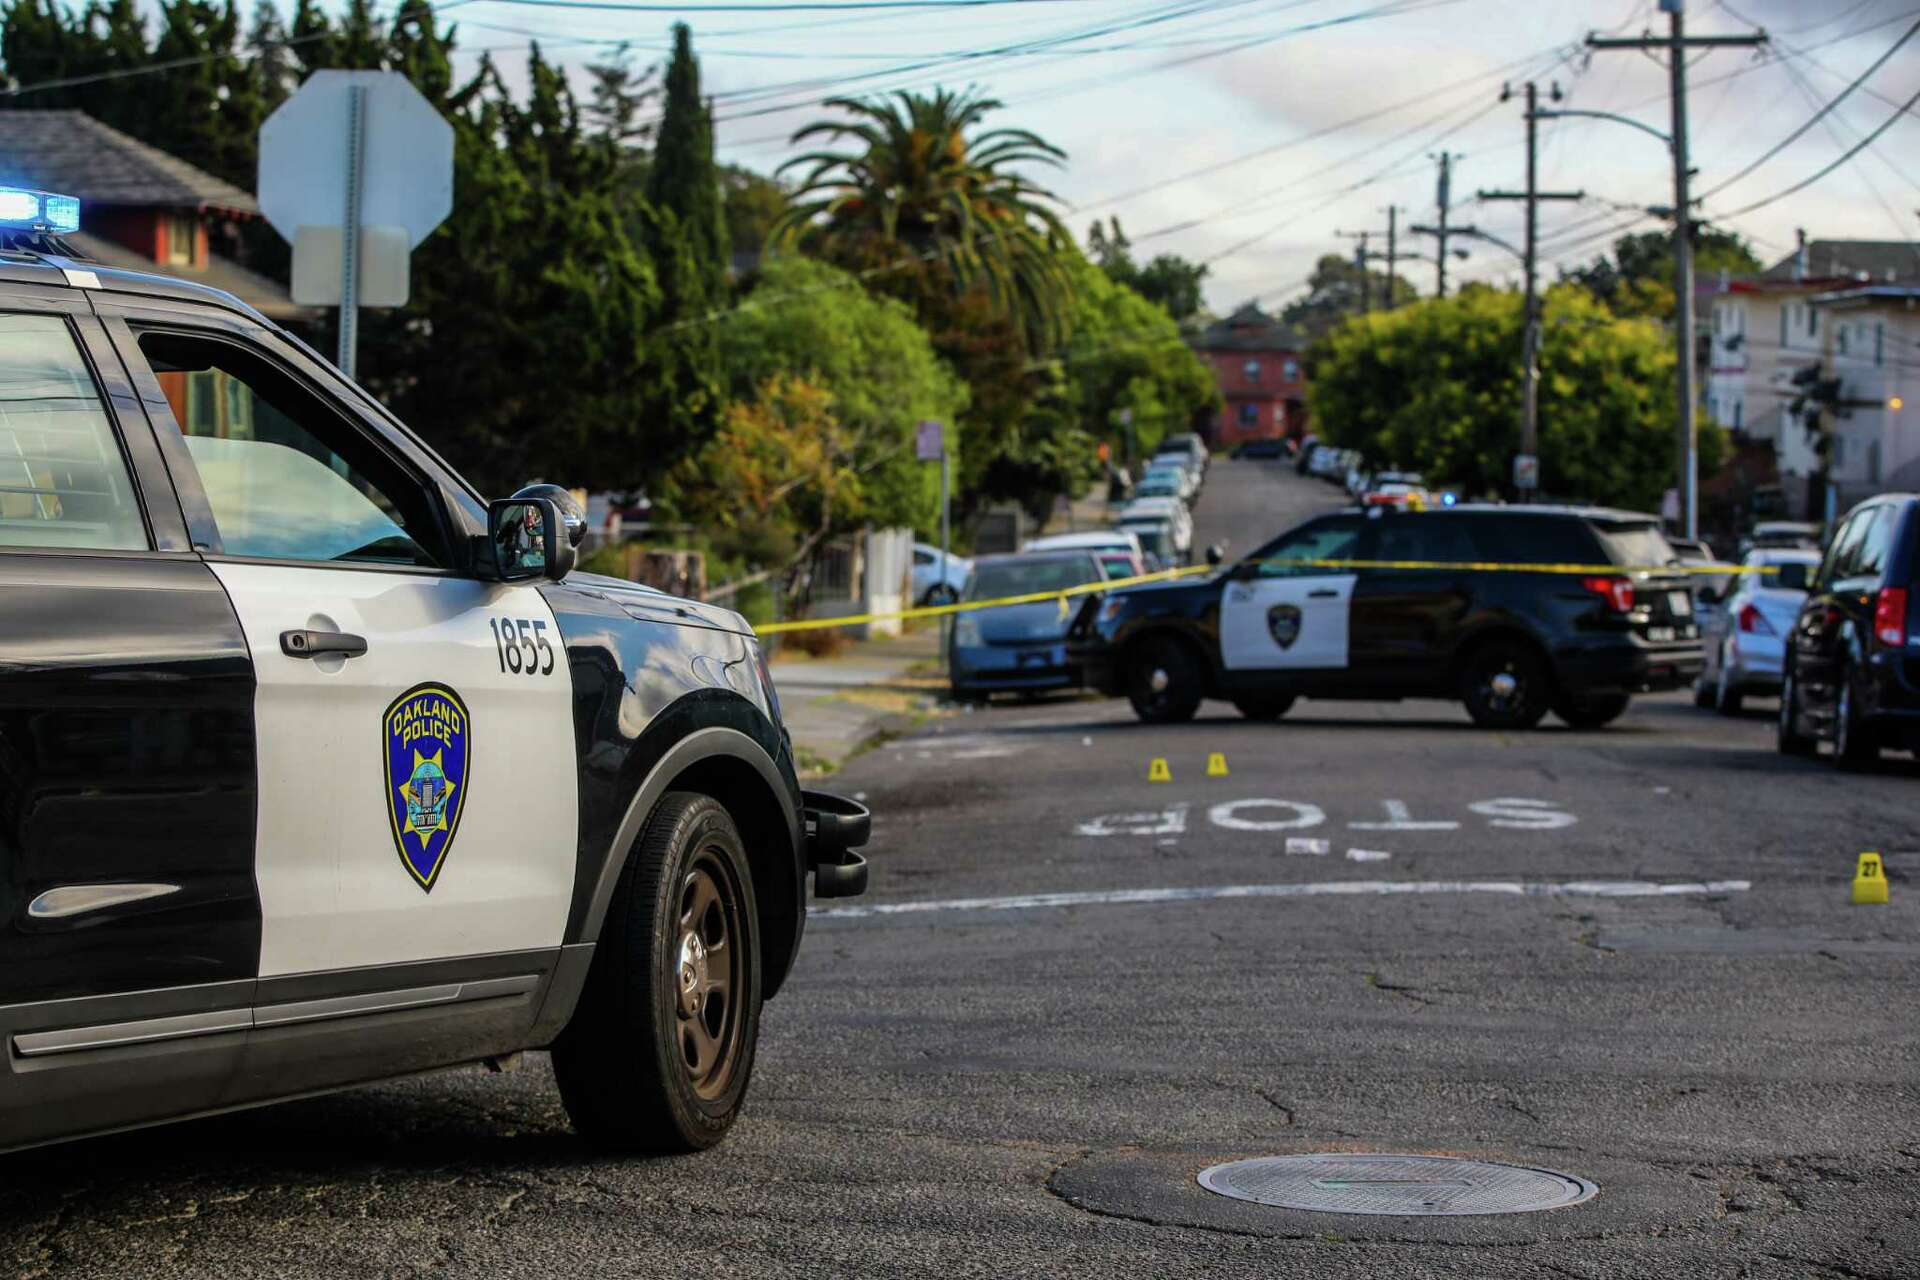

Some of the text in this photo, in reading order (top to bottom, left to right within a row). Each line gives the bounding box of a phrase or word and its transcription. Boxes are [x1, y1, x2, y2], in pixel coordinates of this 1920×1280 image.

[490, 617, 555, 676] 1855
[393, 698, 460, 736] OAKLAND
[403, 718, 452, 750] POLICE
[1075, 799, 1578, 834] STOP
